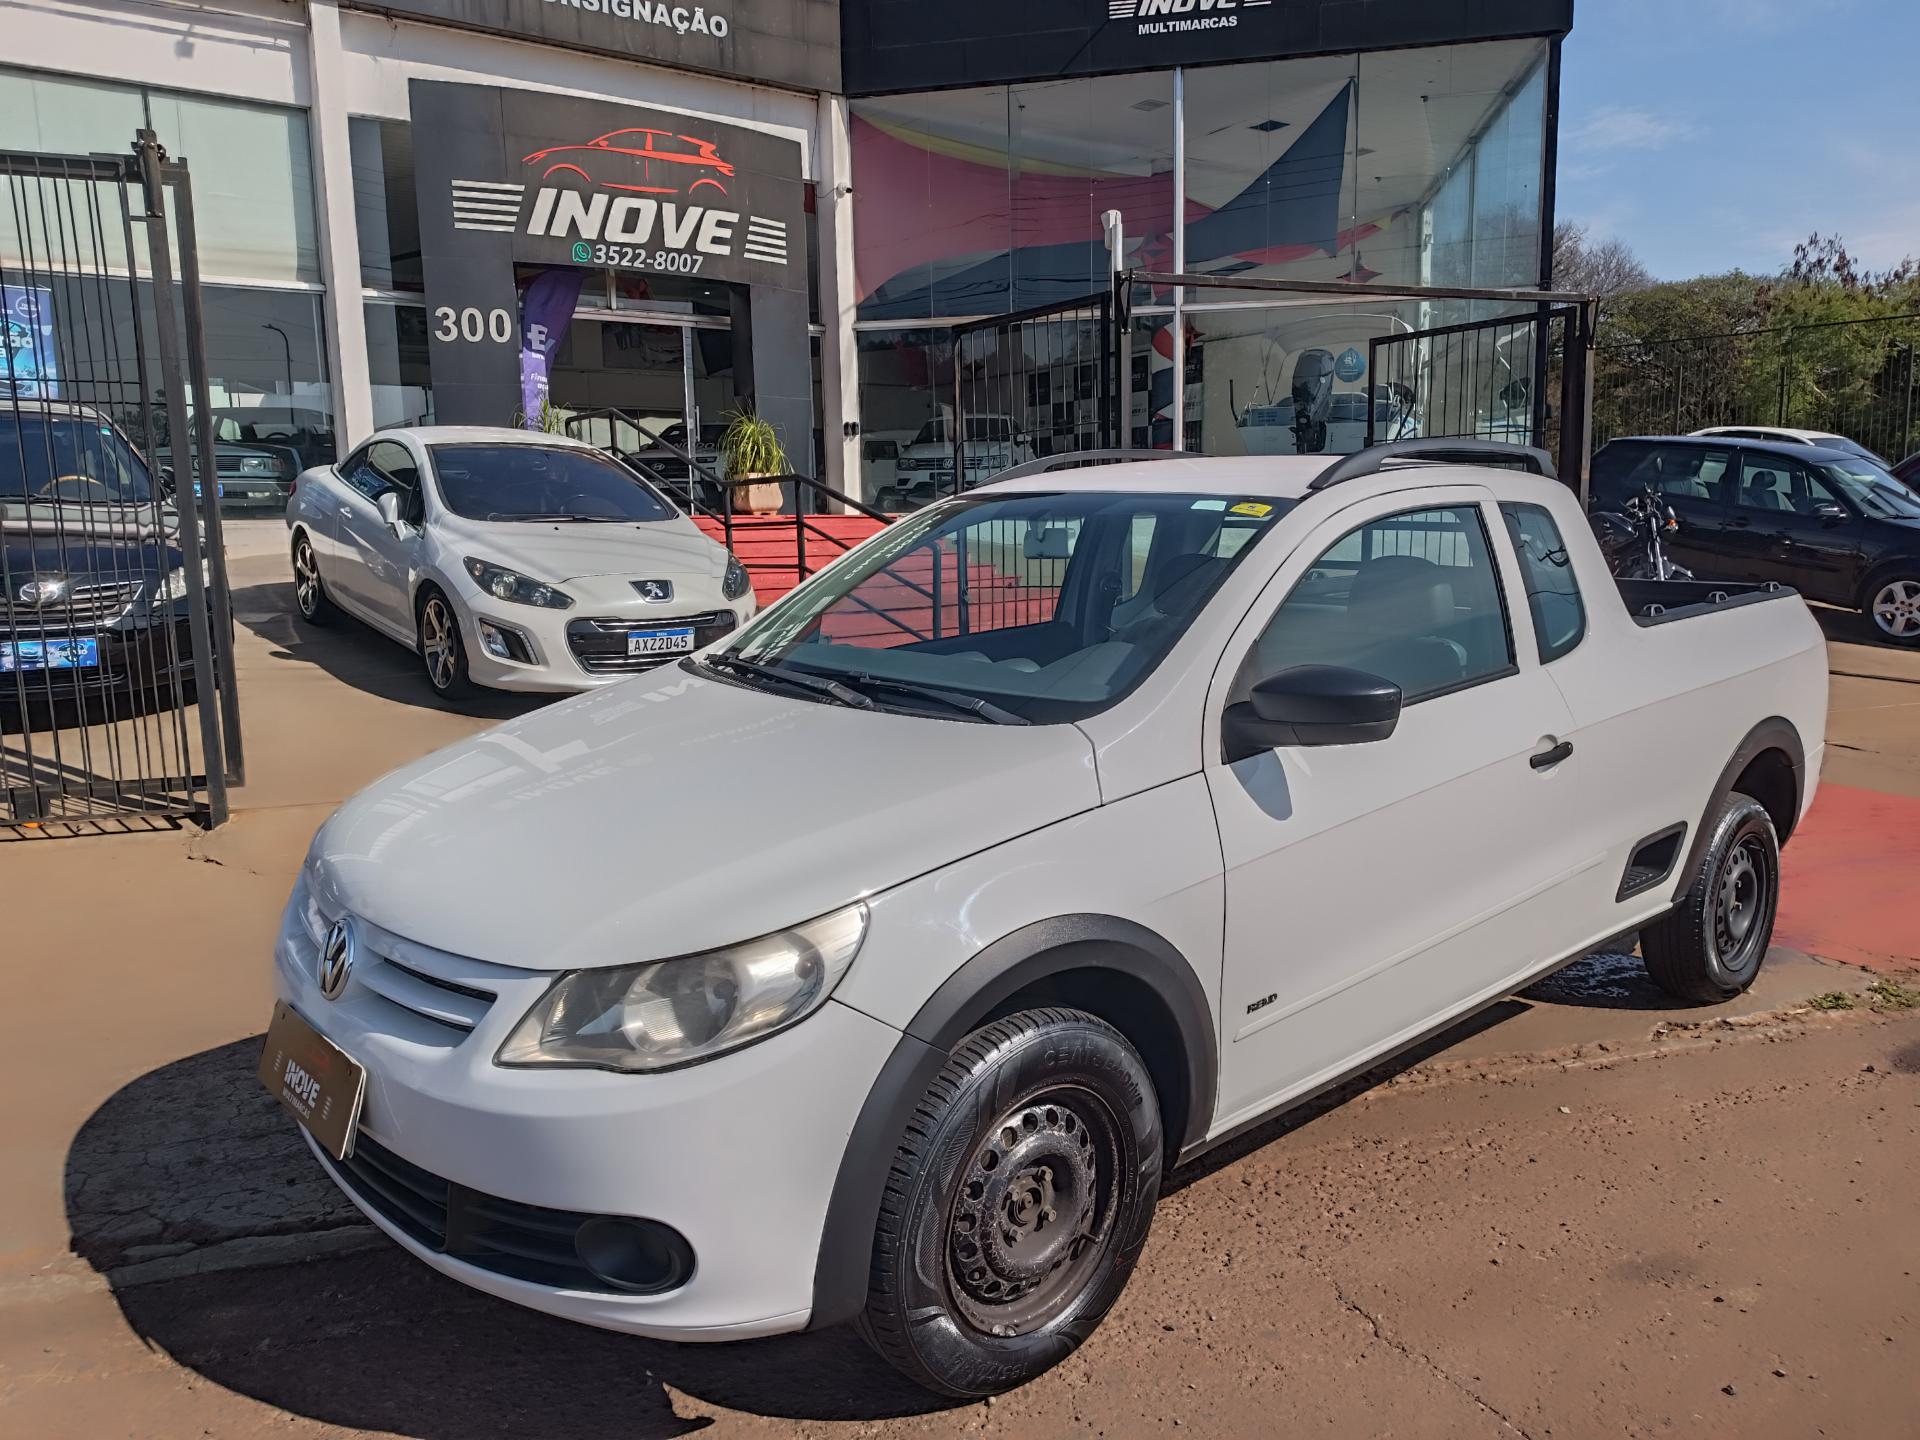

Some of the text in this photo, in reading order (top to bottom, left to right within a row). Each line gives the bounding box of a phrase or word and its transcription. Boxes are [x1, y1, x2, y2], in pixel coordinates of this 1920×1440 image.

[1138, 16, 1238, 35] MULTIMARCAS
[527, 187, 740, 256] INOVE
[593, 244, 704, 274] 3522-8007
[434, 306, 512, 343] 300
[634, 635, 688, 653] AXZ2D45
[284, 1059, 321, 1108] INOVE
